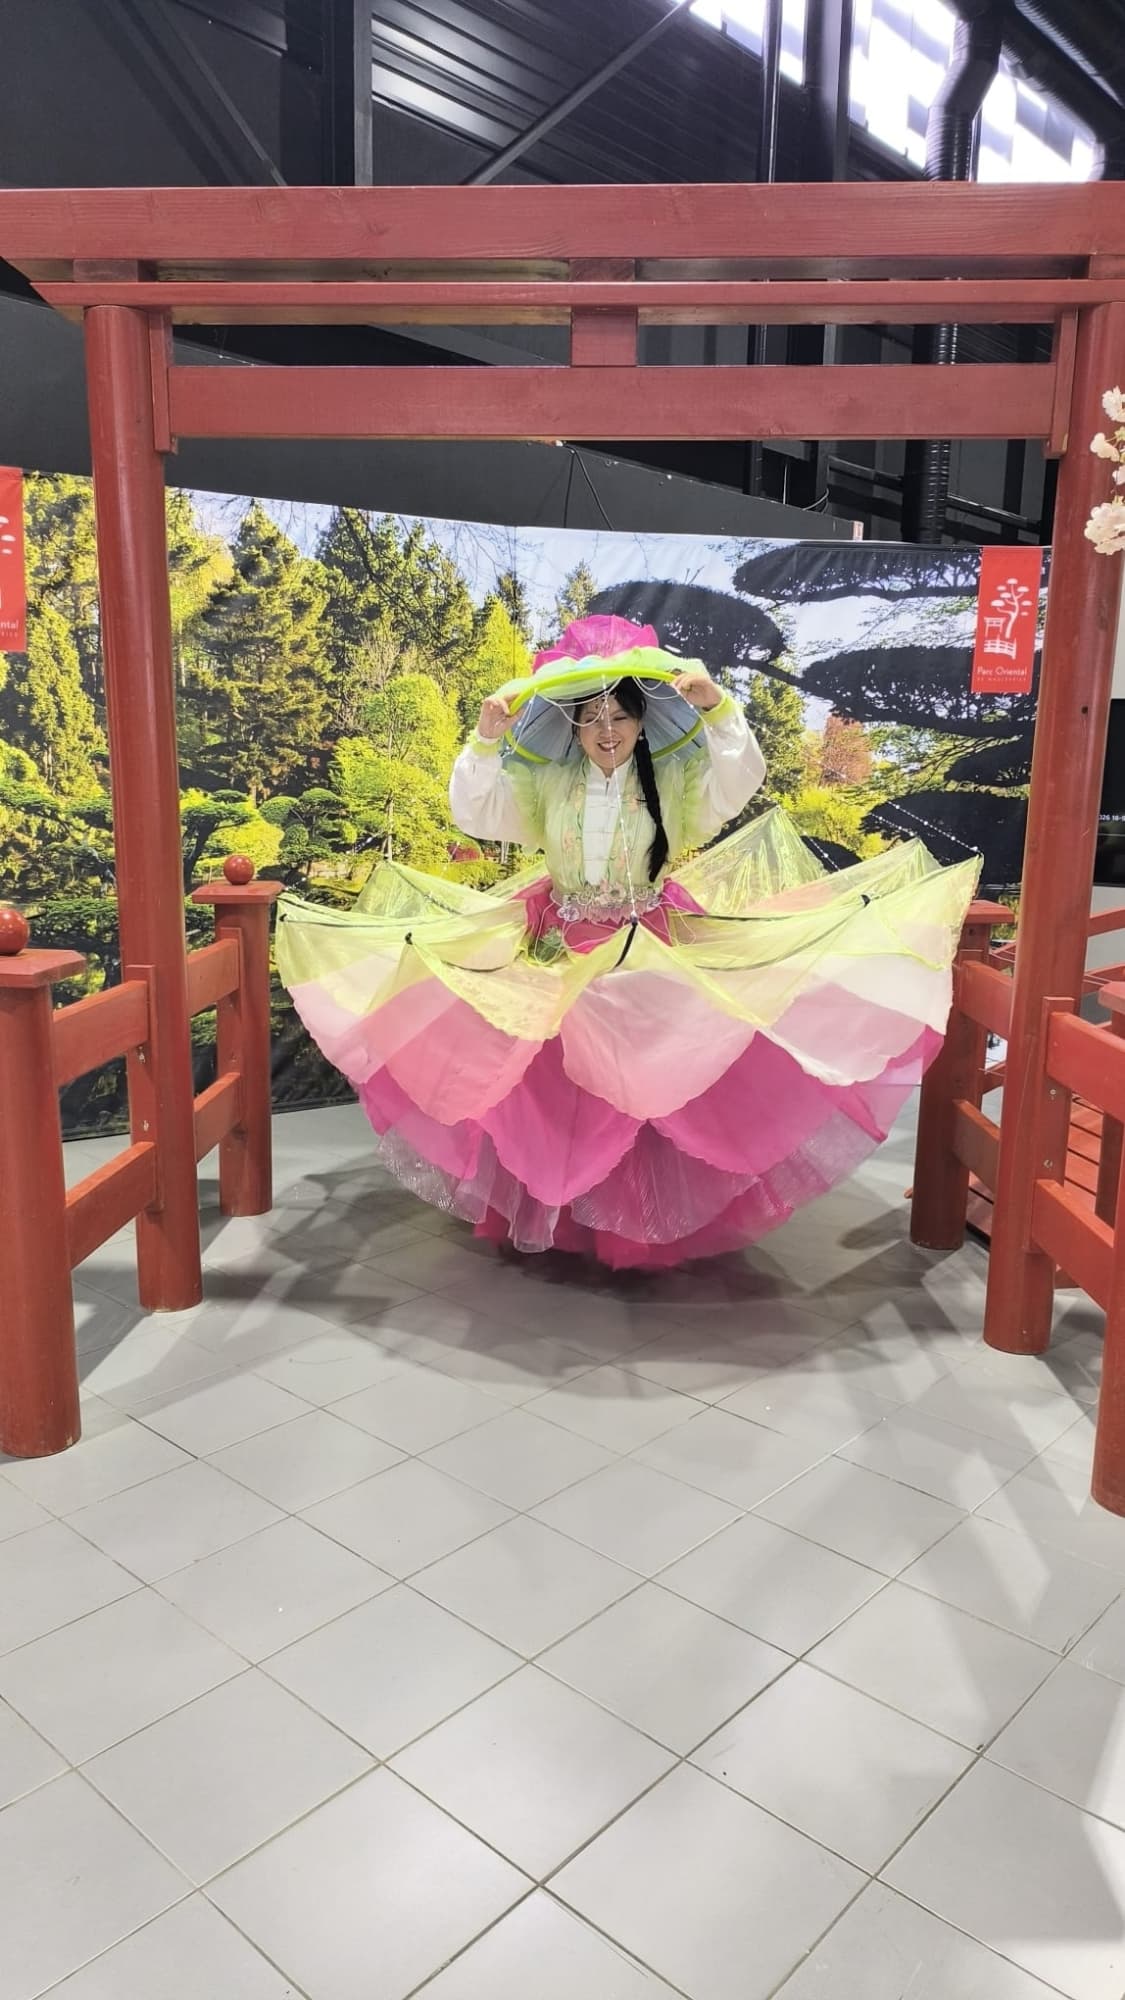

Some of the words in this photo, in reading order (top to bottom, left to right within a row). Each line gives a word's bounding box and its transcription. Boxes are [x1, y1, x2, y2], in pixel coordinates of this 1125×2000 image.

[0, 619, 19, 629] ntal
[977, 666, 993, 675] Parc
[995, 666, 1027, 675] Oriental
